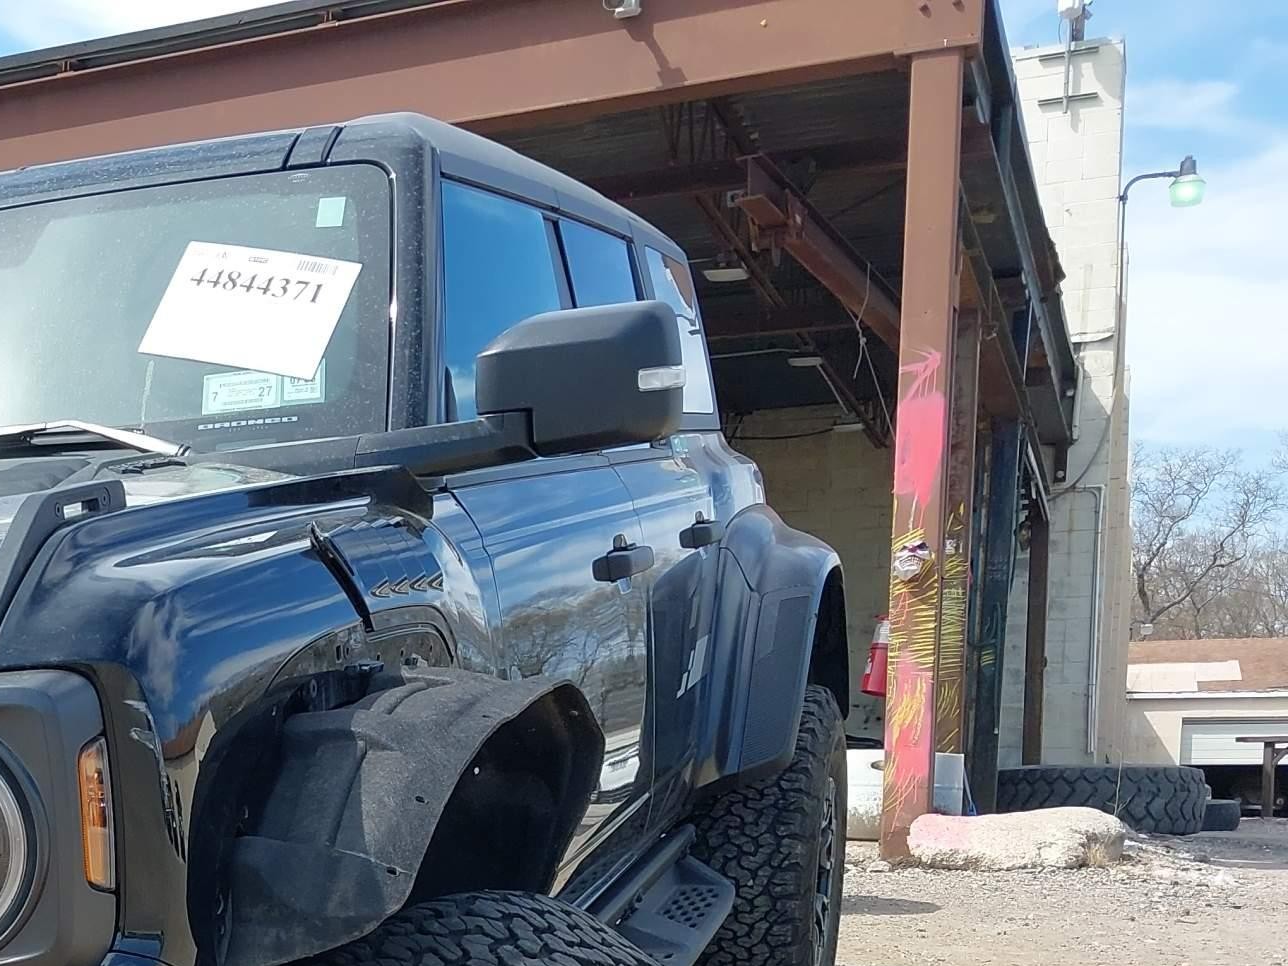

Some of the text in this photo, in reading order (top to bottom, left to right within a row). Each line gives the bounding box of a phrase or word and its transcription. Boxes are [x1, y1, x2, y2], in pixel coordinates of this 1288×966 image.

[190, 268, 323, 303] 44844371
[258, 386, 272, 398] 27
[198, 416, 298, 430] BRONCO
